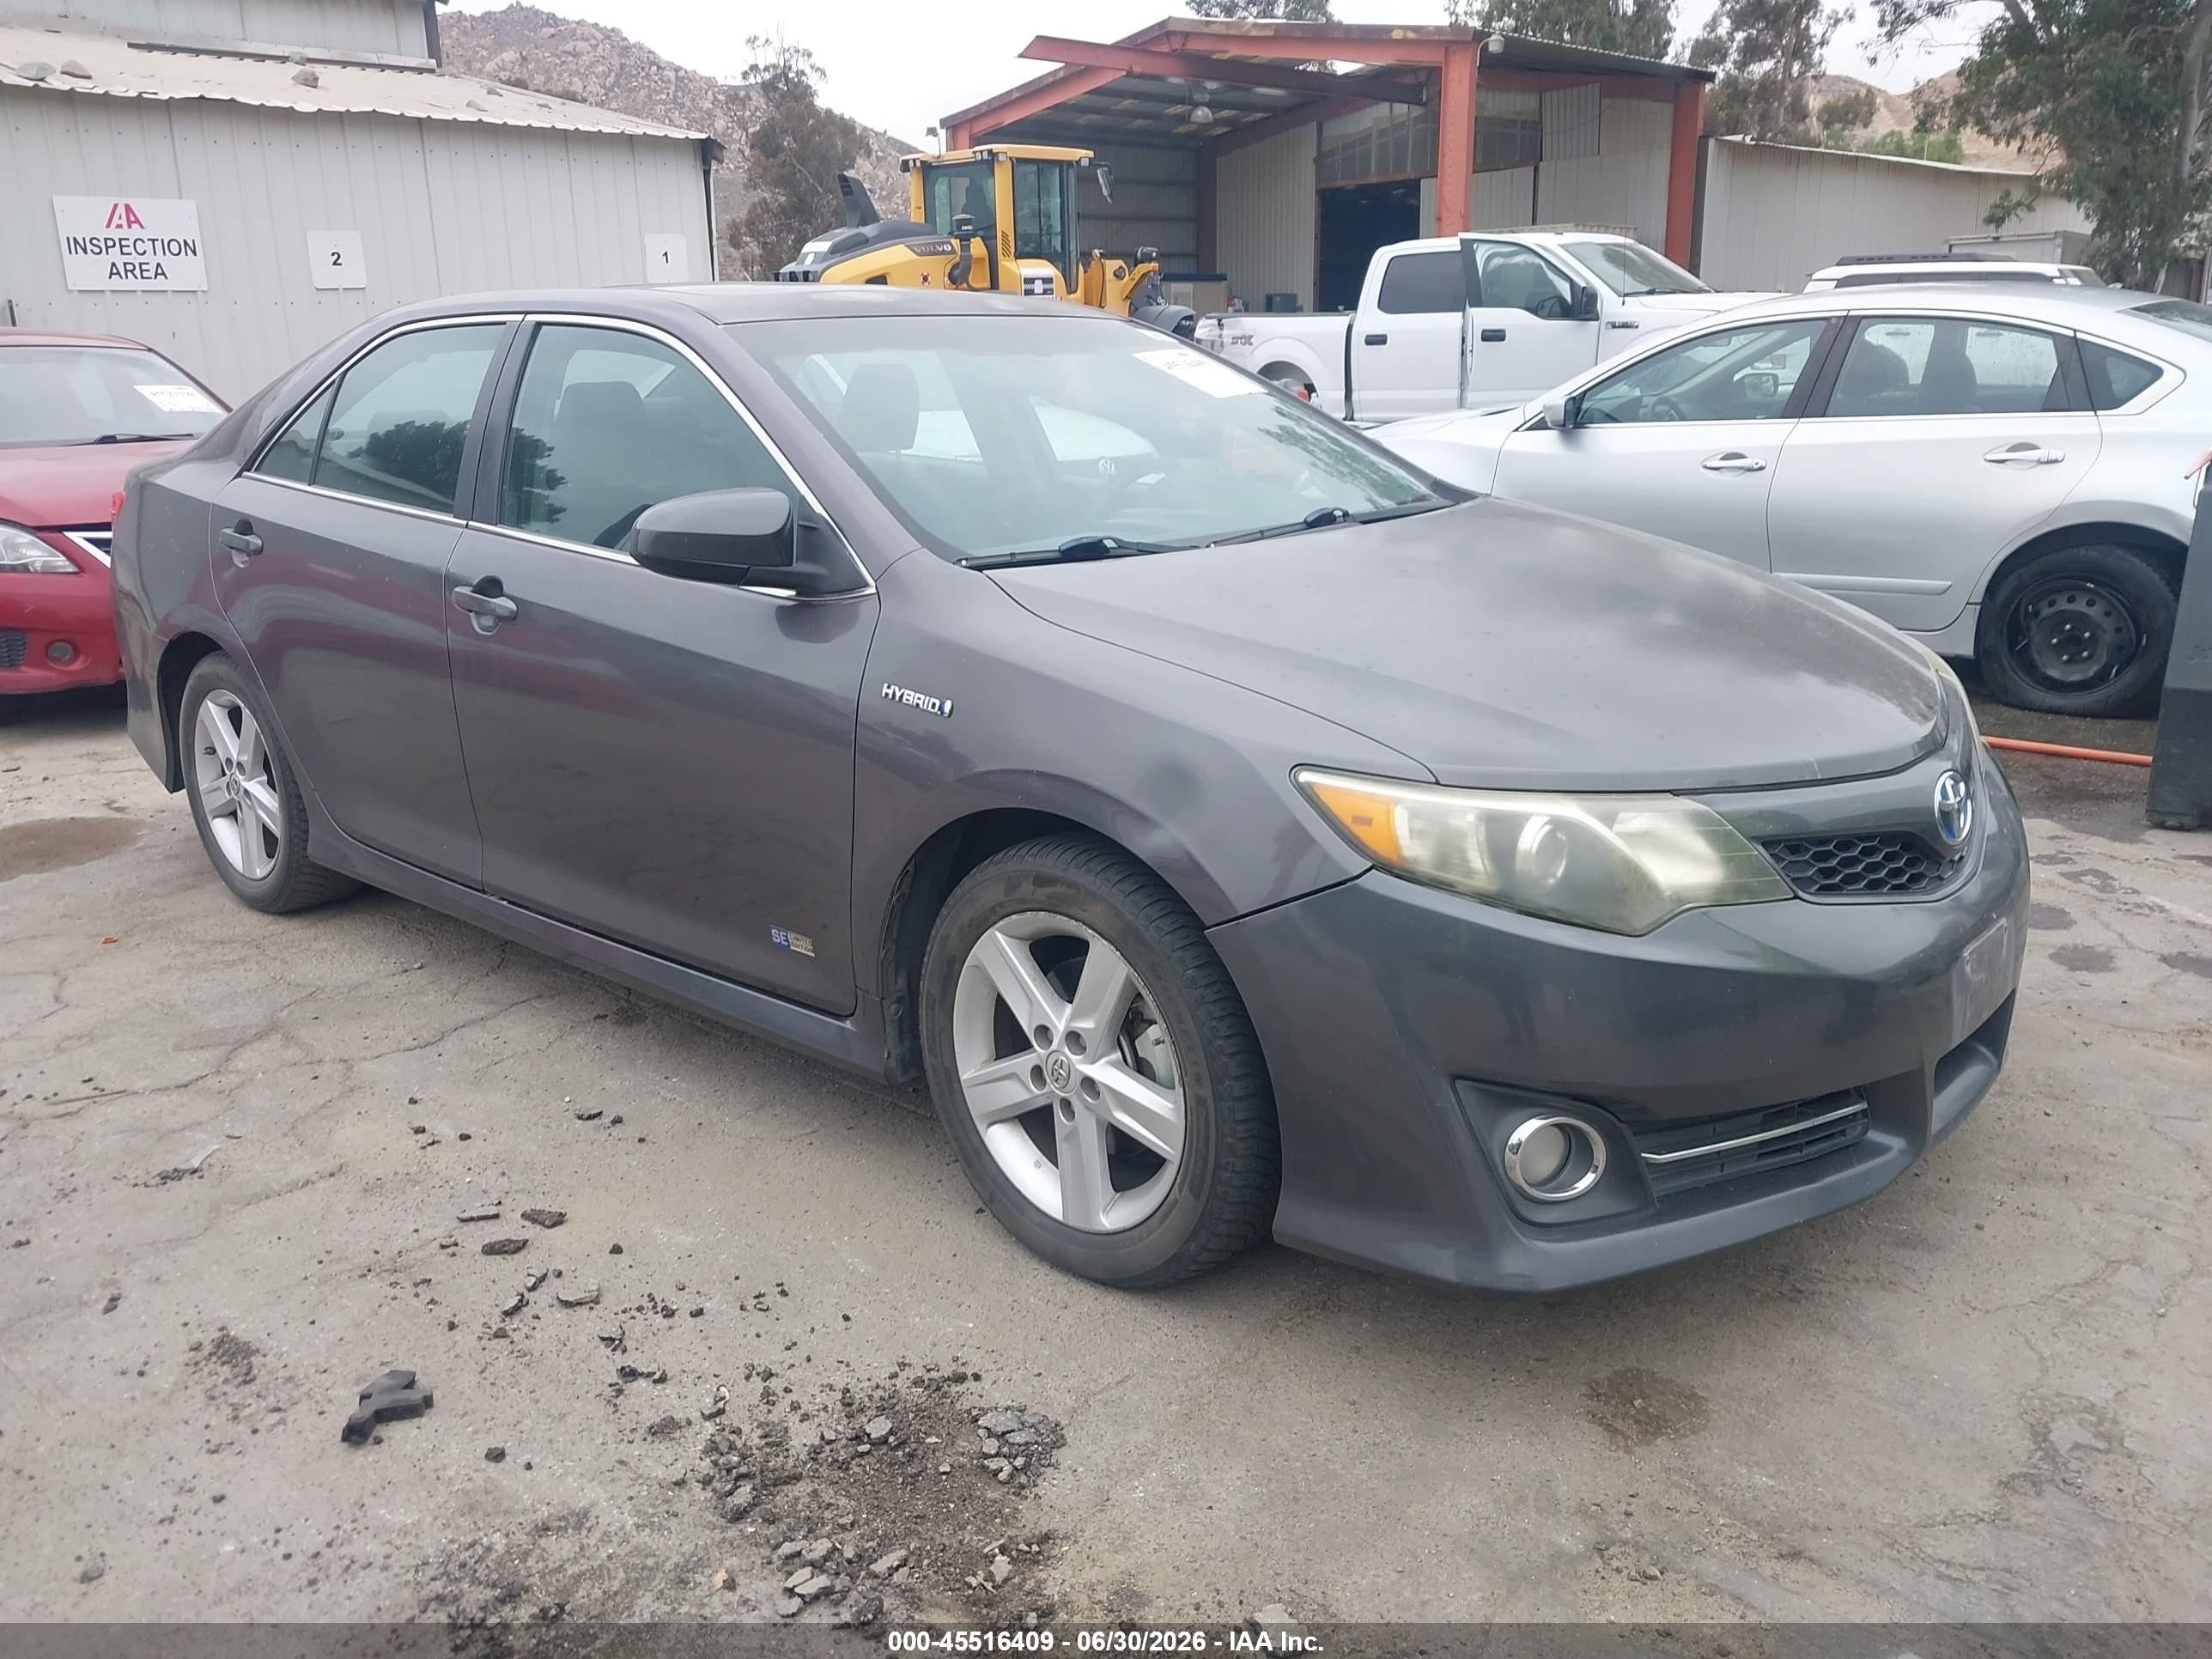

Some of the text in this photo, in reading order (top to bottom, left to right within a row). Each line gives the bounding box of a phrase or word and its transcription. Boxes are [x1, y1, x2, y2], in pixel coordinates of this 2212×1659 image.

[66, 236, 198, 257] INSPECTION
[914, 244, 952, 252] VOLVO
[330, 252, 343, 266] 2
[661, 250, 669, 264] 1
[108, 261, 168, 280] AREA
[881, 683, 941, 713] HYBRID
[771, 928, 789, 945] SE
